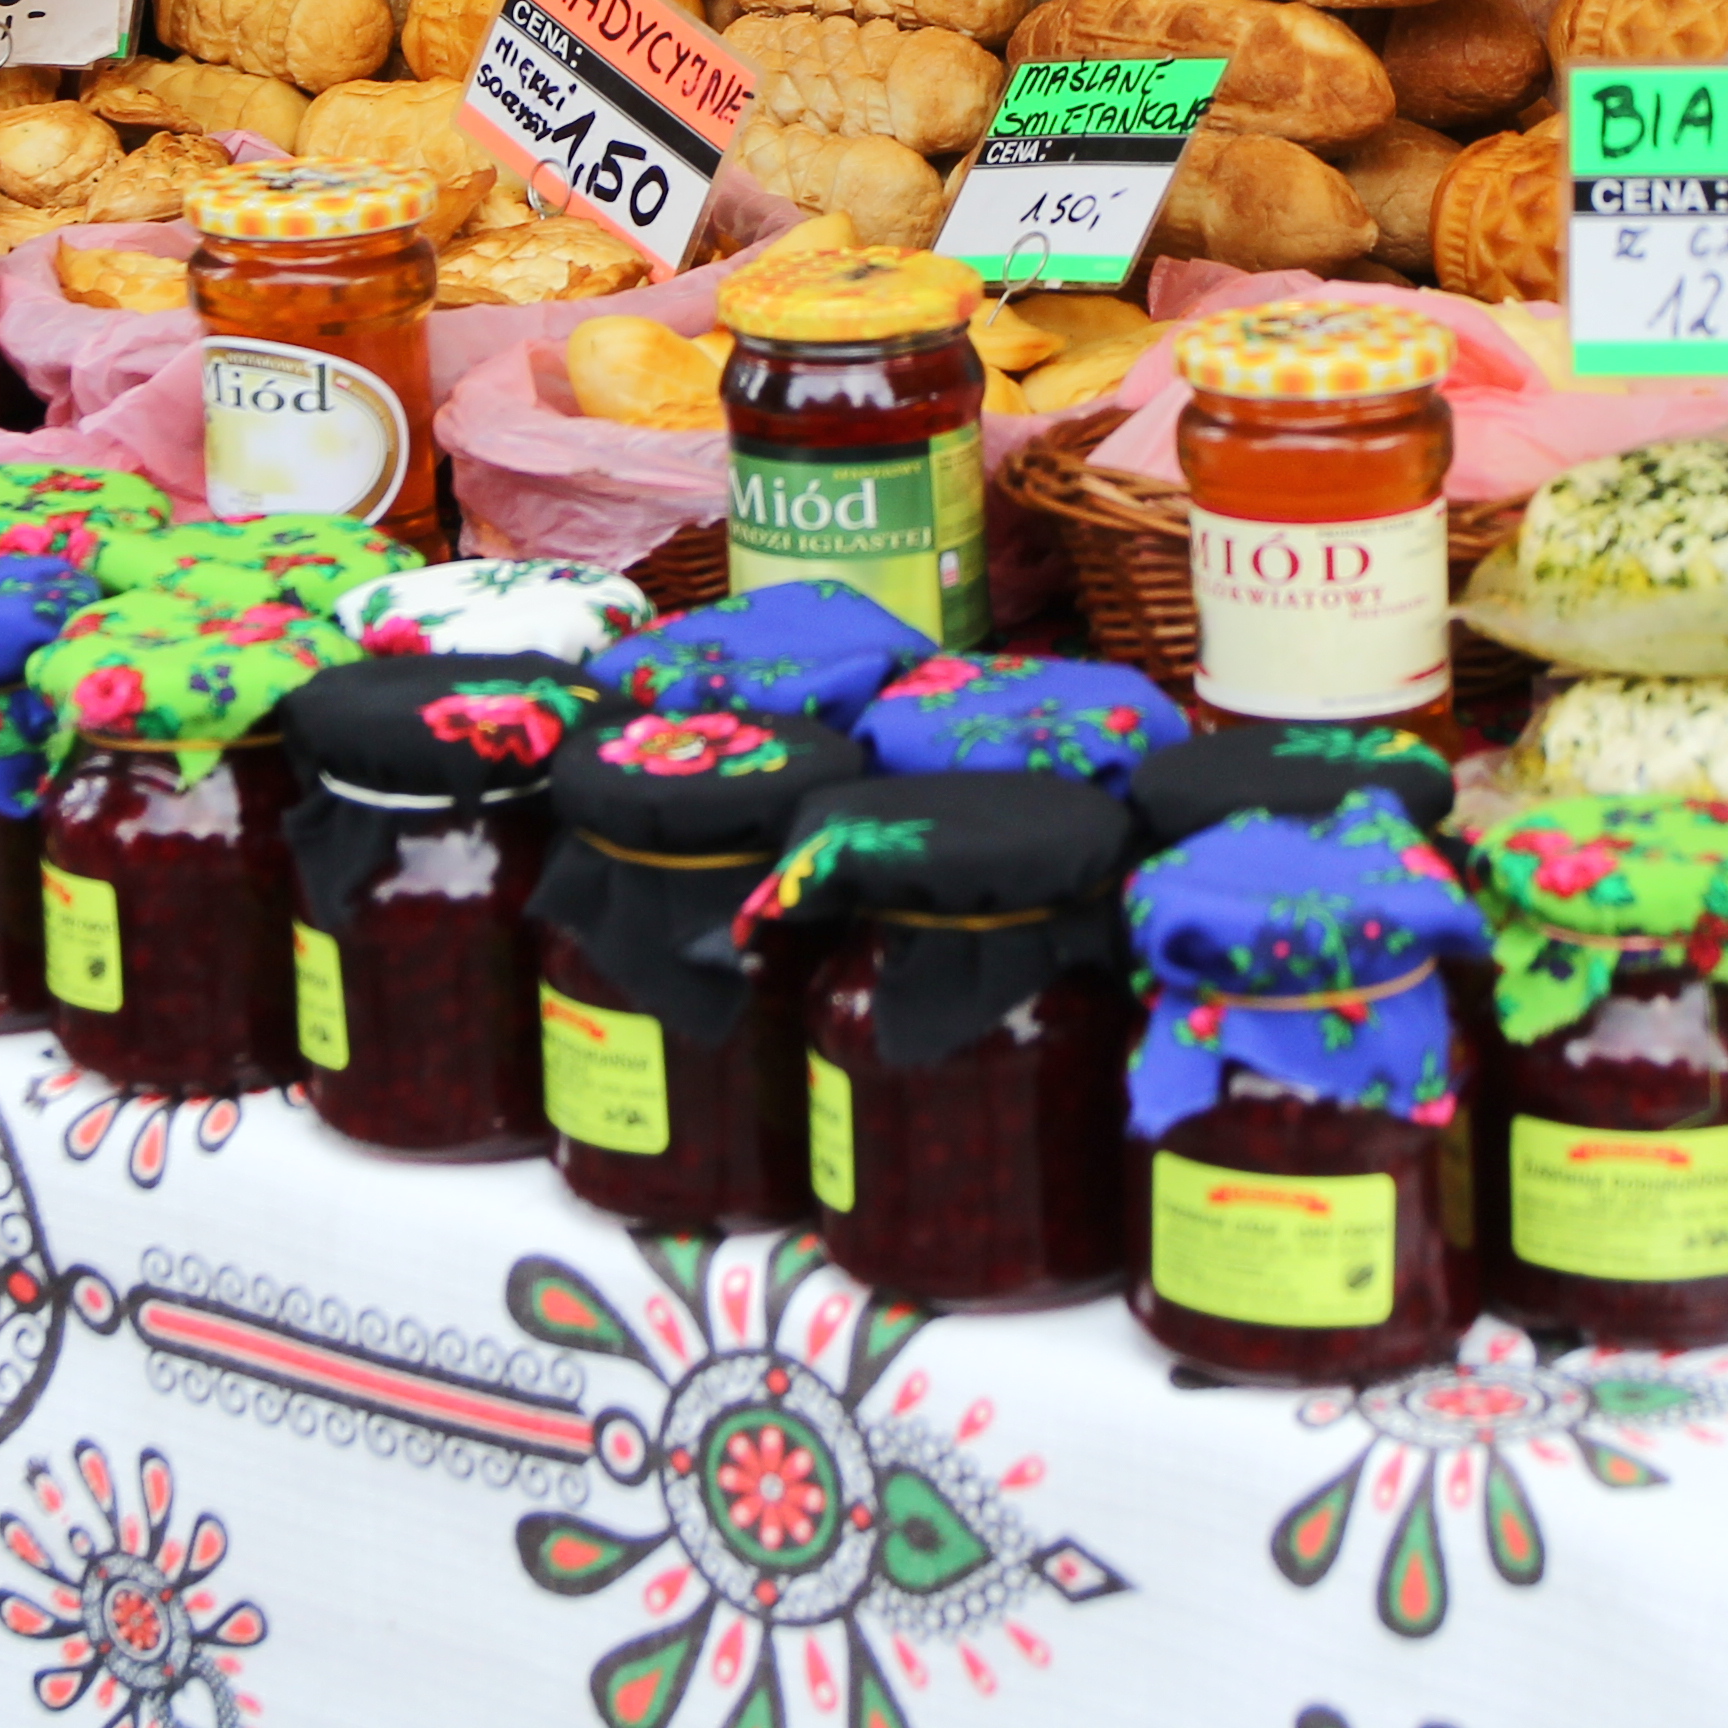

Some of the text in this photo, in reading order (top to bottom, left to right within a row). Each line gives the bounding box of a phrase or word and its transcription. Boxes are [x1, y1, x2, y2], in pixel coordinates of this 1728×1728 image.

[511, 0, 584, 69] CENA:
[986, 139, 1053, 165] CENA:
[729, 465, 879, 532] Miód
[798, 526, 933, 553] IGLASTEJ
